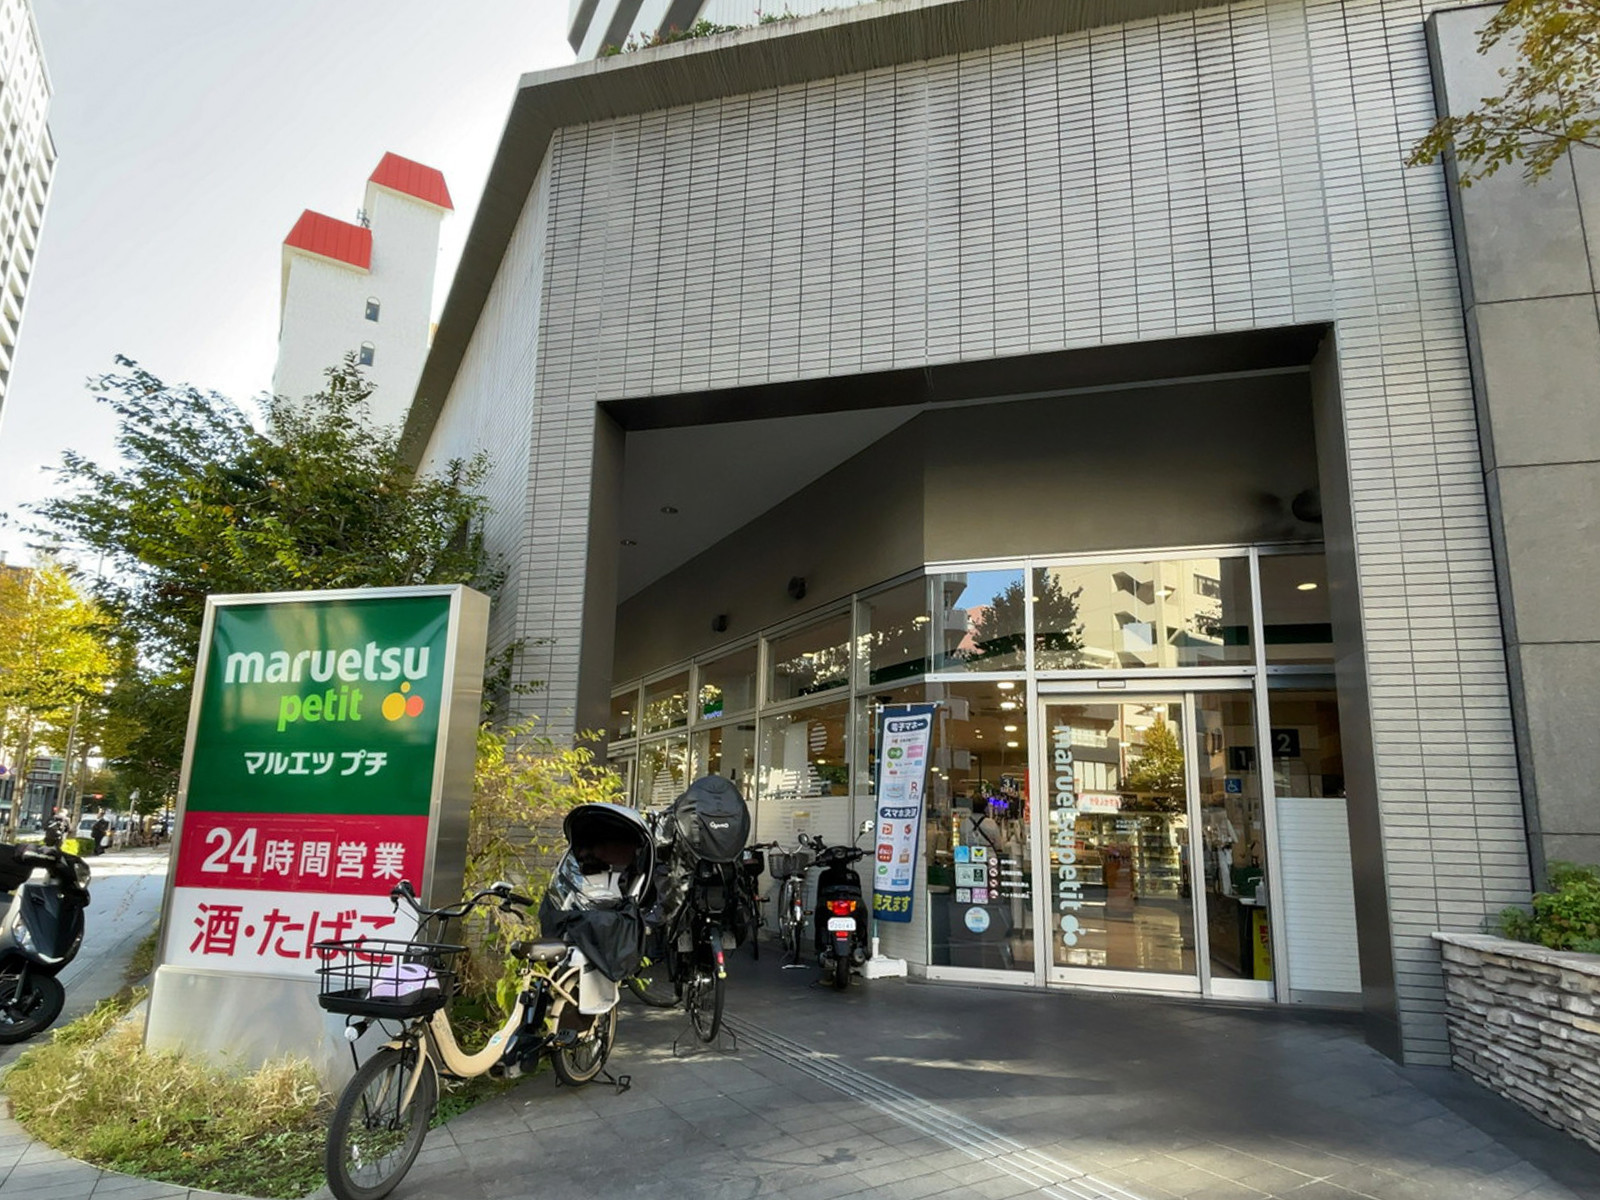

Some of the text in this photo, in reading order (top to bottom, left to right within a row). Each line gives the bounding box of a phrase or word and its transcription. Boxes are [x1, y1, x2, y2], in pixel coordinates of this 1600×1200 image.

[225, 641, 431, 684] maruetsu
[277, 687, 364, 732] petit
[244, 749, 388, 776] マルエツ プチ
[1277, 733, 1291, 752] 2
[201, 827, 406, 880] 24時間営業
